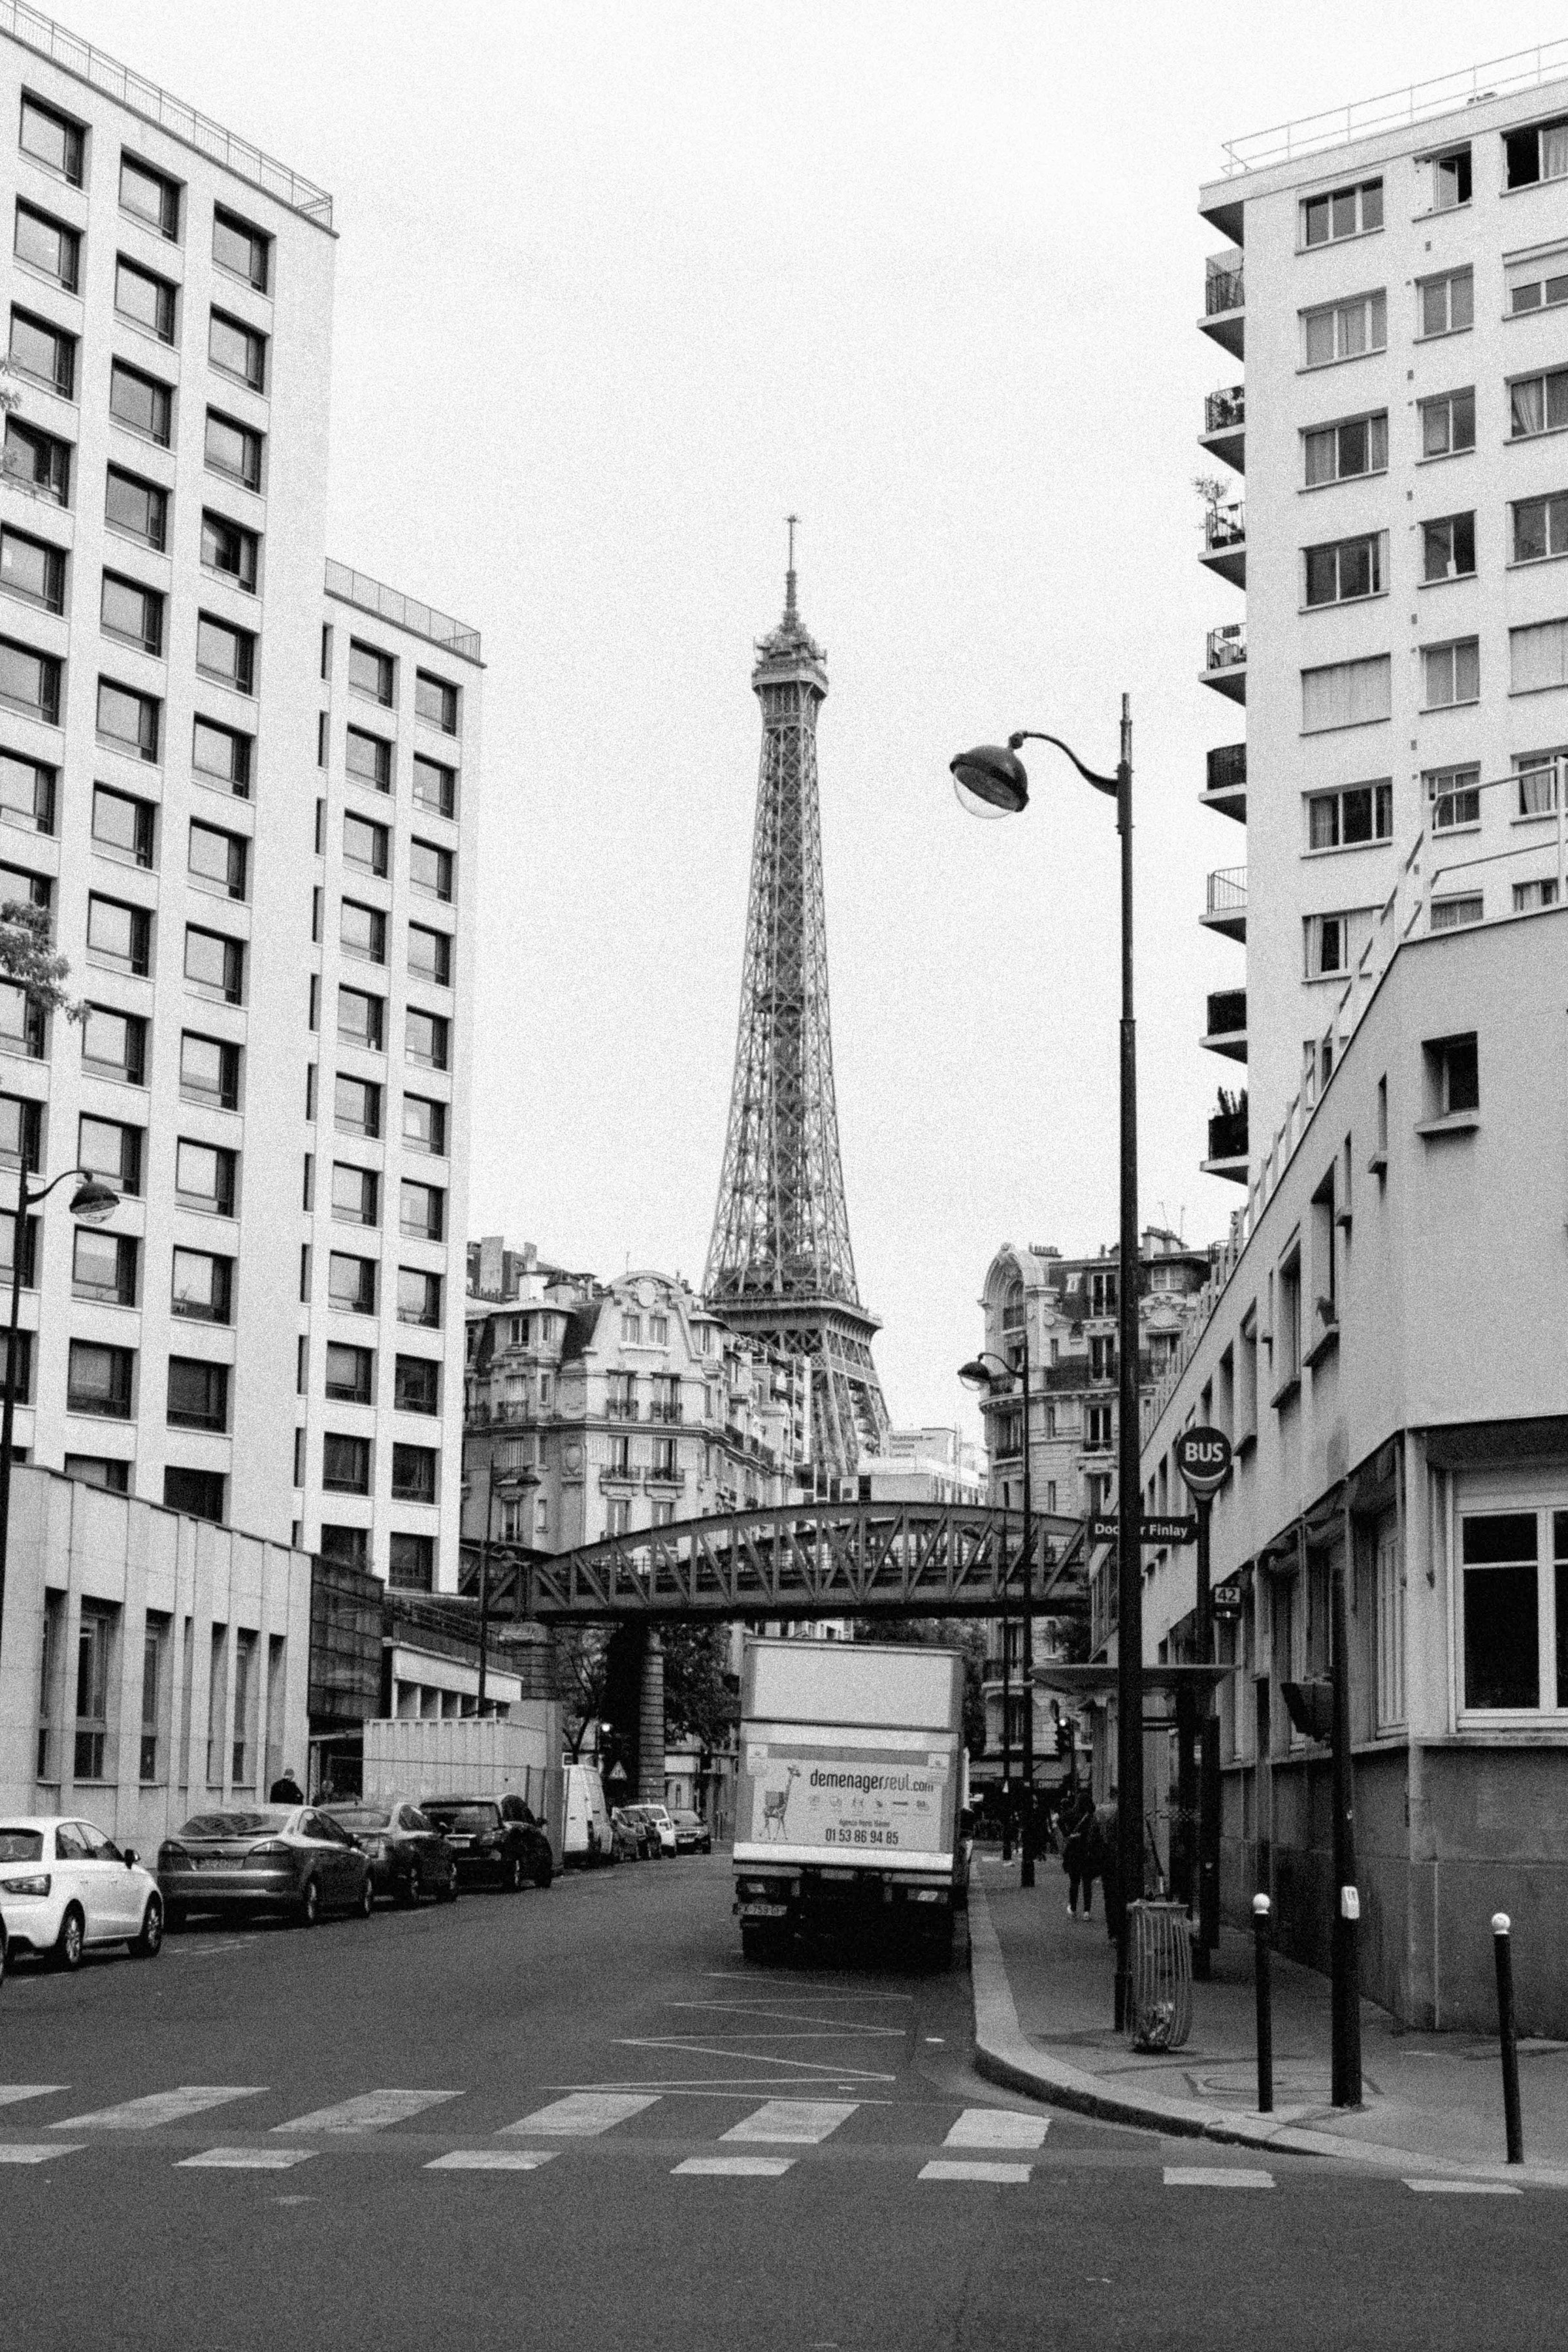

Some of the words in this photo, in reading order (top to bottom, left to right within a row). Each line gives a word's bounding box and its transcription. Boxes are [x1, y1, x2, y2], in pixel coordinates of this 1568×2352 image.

[1185, 1442, 1223, 1462] BUS
[1095, 1523, 1146, 1535] Docr
[1149, 1524, 1188, 1539] Finlay
[1217, 1588, 1237, 1601] 42
[810, 1769, 934, 1793] demenagerseul.com
[825, 1828, 836, 1842] 01
[839, 1829, 851, 1842] 53
[854, 1829, 867, 1843] 86
[870, 1831, 882, 1844] 94
[886, 1831, 899, 1845] 85
